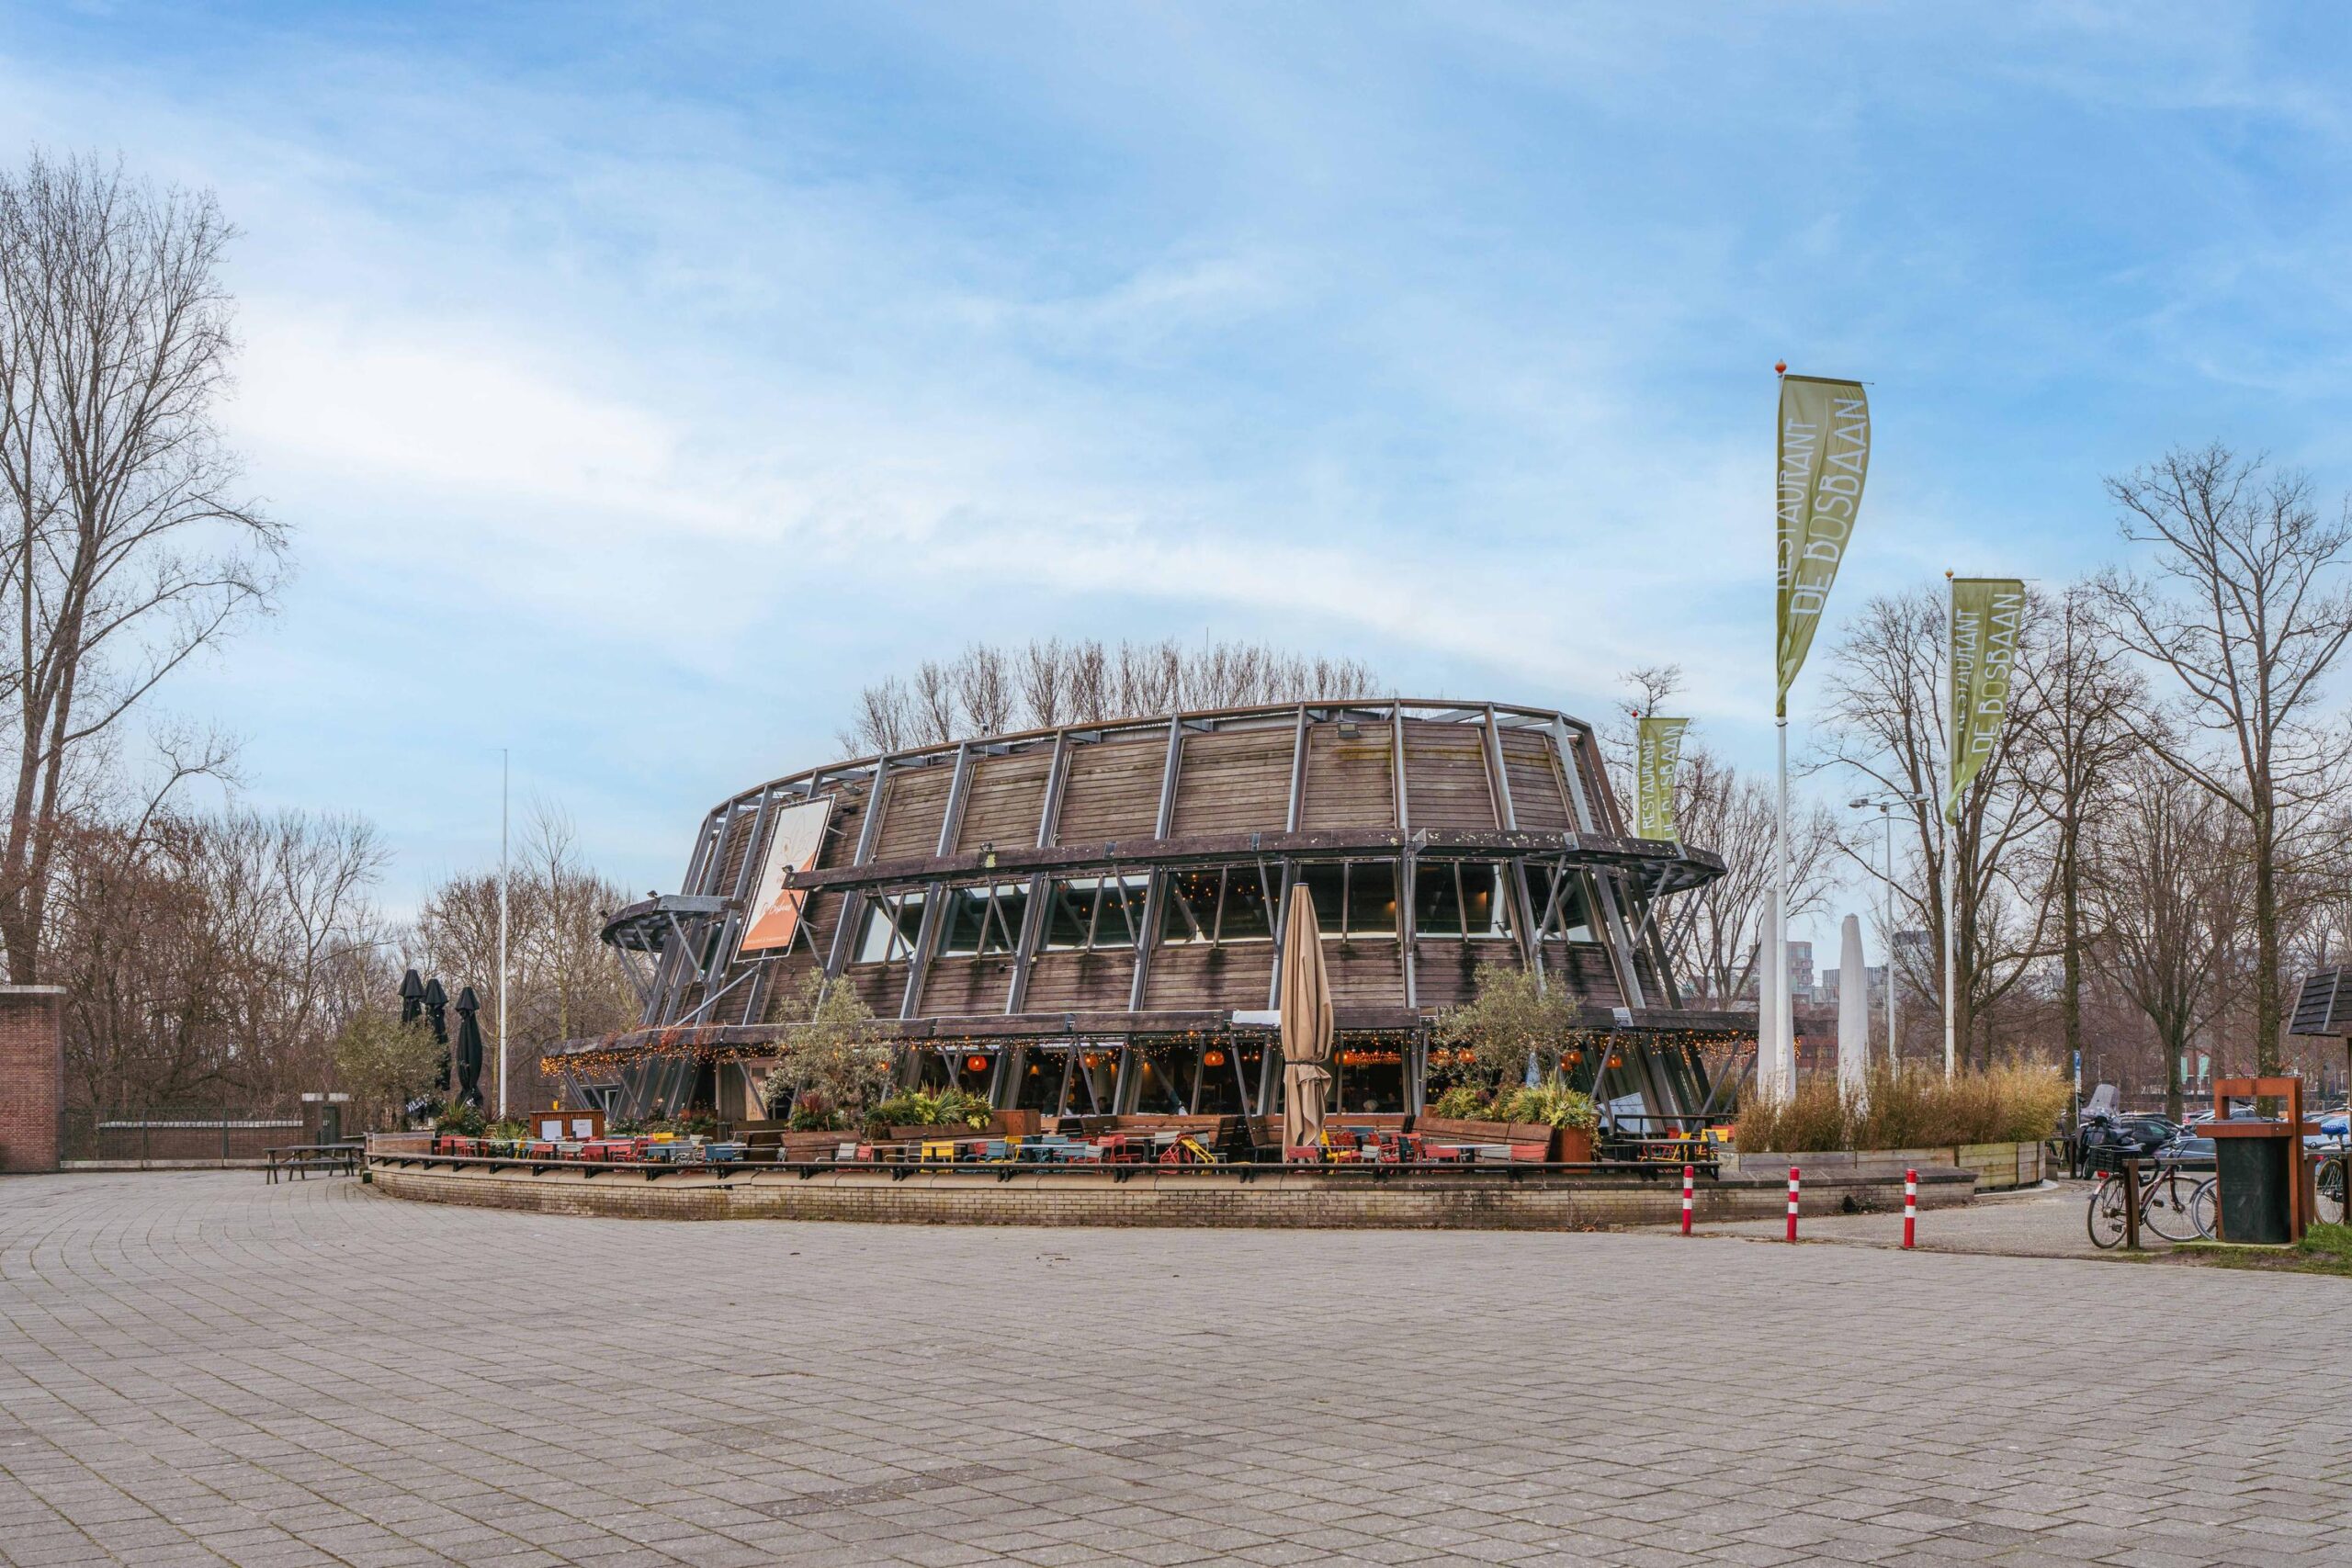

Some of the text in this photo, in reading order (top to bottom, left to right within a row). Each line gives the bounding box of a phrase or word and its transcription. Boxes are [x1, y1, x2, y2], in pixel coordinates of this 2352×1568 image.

[1790, 398, 1867, 615] DE BOSBAAN
[1971, 593, 2021, 753] DE BOSBAAN
[1641, 739, 1656, 829] RESTAURANT
